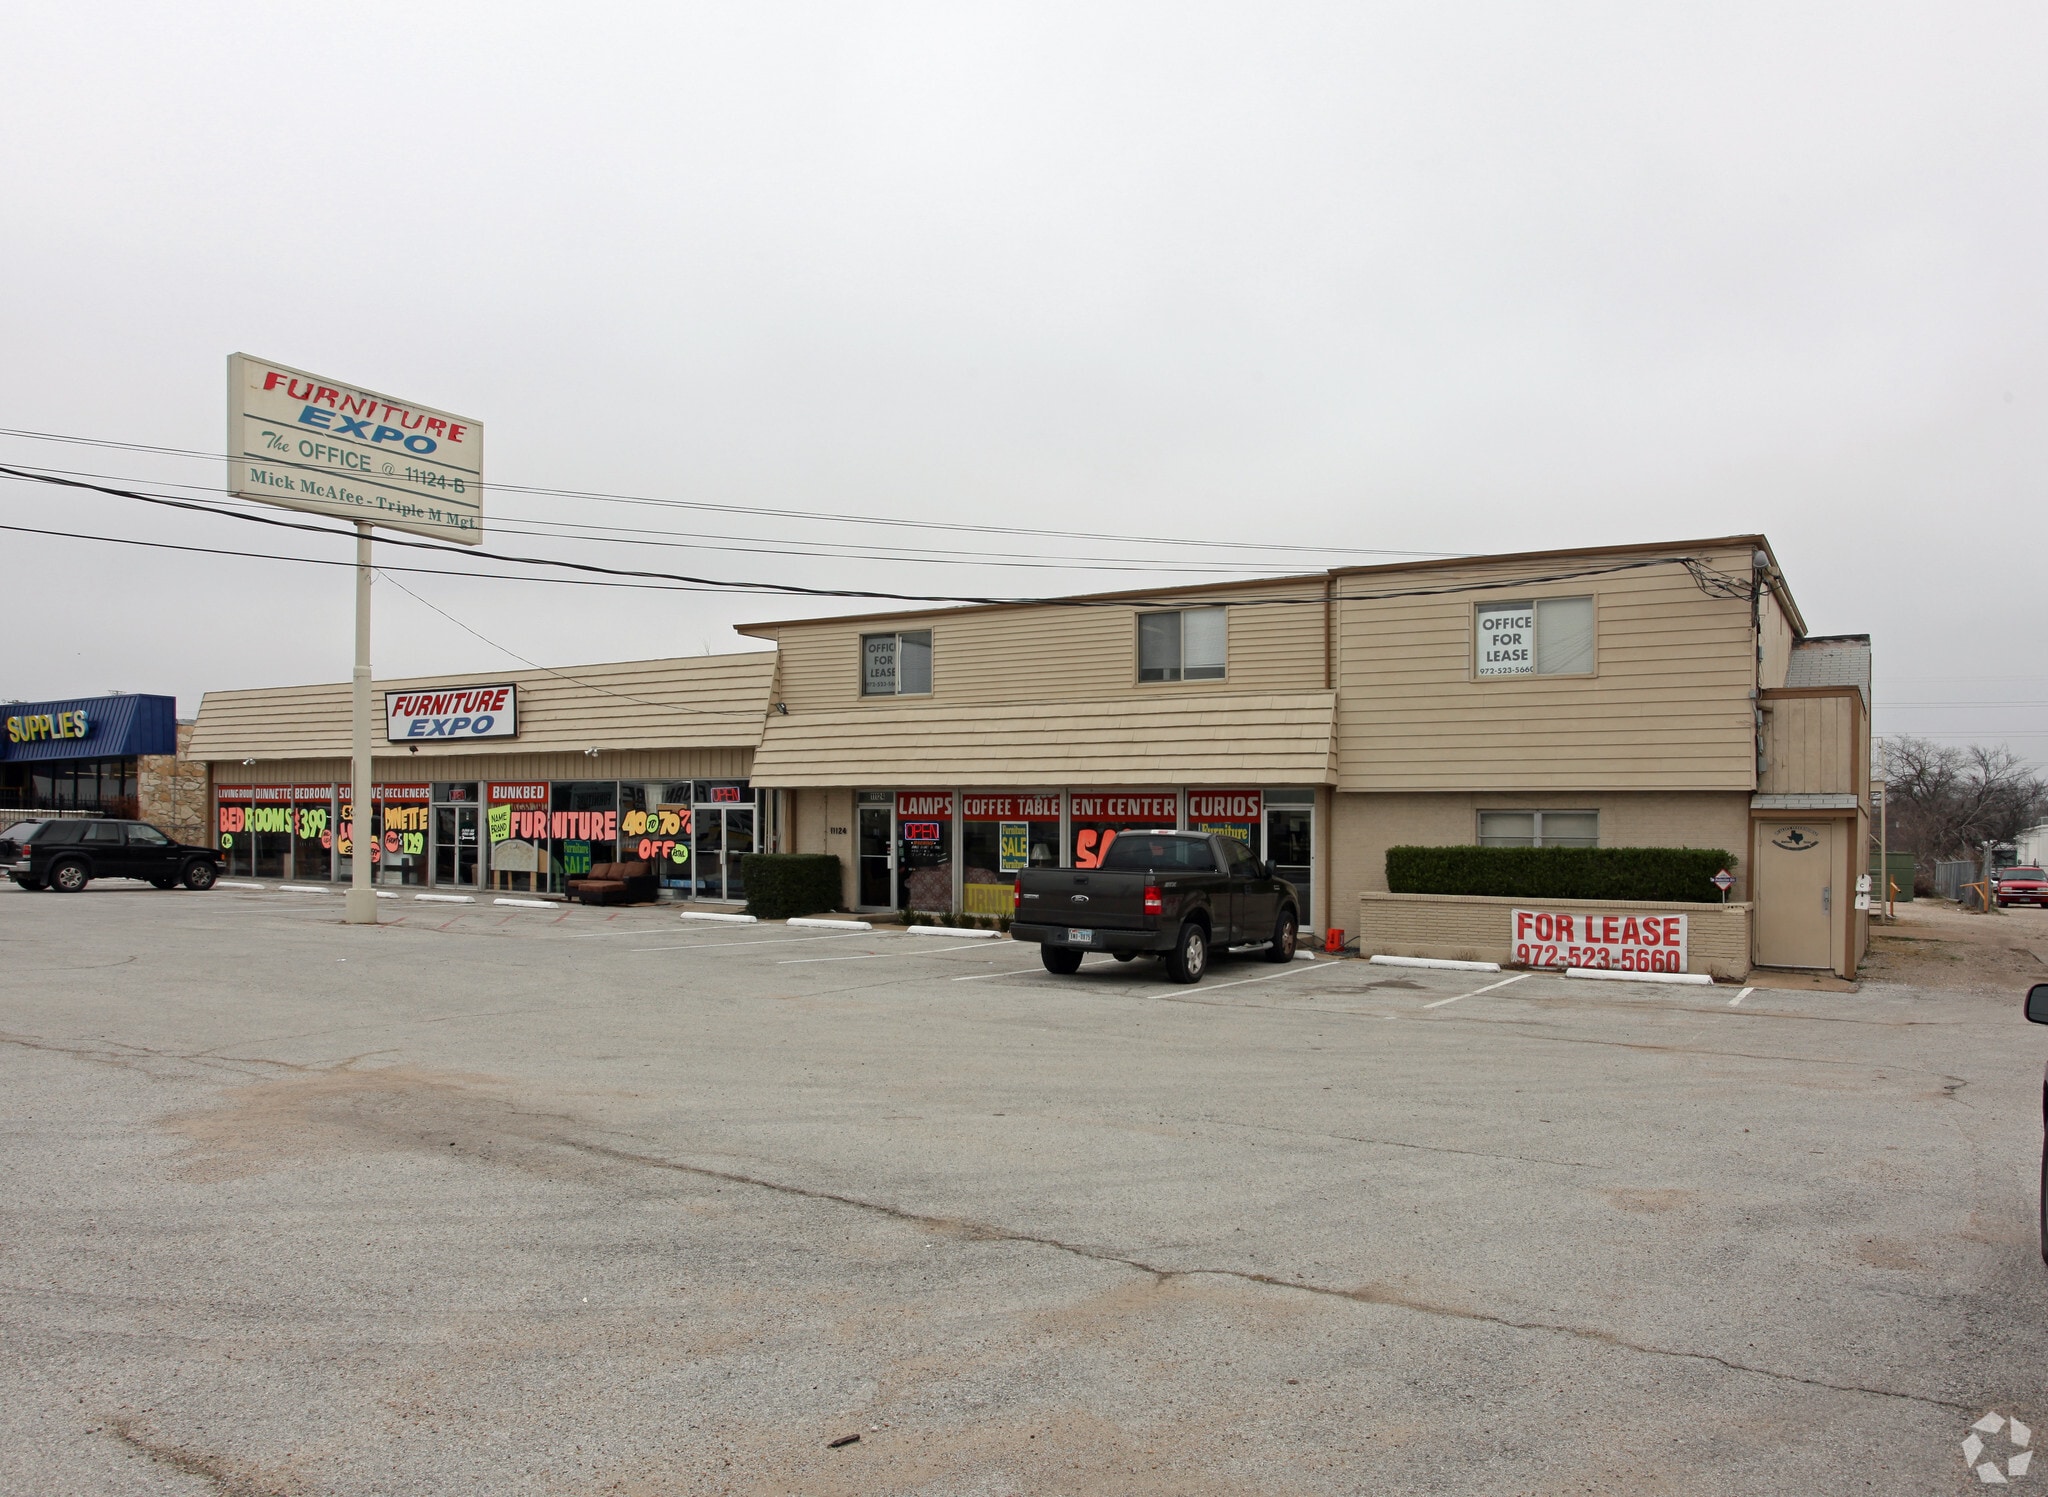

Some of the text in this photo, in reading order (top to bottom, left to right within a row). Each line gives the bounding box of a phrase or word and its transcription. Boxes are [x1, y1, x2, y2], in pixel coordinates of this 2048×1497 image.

[263, 371, 467, 443] FURNITURE
[298, 405, 437, 454] EXPO
[261, 430, 465, 494] The OFFICE @ 11124-B
[250, 468, 295, 491] Mick
[300, 478, 364, 506] McAfee
[375, 496, 424, 519] Triple
[428, 505, 442, 522] M
[1483, 616, 1531, 630] OFFICE
[869, 643, 896, 653] OFFIC
[1493, 633, 1522, 646] FOR
[874, 656, 893, 665] FOR
[1487, 649, 1528, 662] LEASE
[392, 689, 509, 717] FURNITURE
[7, 710, 89, 743] SUPPLIES
[407, 715, 495, 737] EXPO
[219, 789, 239, 798] LIVING
[256, 788, 292, 799] DINNETTE
[295, 788, 332, 799] BEDROOM
[385, 788, 429, 798] RECLIENERS
[493, 786, 544, 799] BUNKBED
[713, 788, 738, 801] OPEN
[899, 797, 952, 815] LAMPS
[964, 799, 1059, 816] COFFEE TABLE
[1072, 799, 1175, 816] ENT. CENTER
[1190, 797, 1258, 817] CURIOS
[220, 807, 292, 833] BEDROOMS
[491, 812, 507, 822] NAME
[510, 811, 616, 840] FURNITURE
[622, 810, 647, 837] 40
[491, 823, 507, 834] BRAND
[830, 827, 847, 835] 11124
[906, 824, 938, 839] OPEN
[1003, 825, 1026, 835] Furniture
[1202, 823, 1248, 840] Furniture
[638, 839, 675, 859] OFF
[1002, 837, 1027, 857] SALE
[1518, 912, 1680, 947] FOR LEASE
[1517, 943, 1680, 973] 972-523-5660
